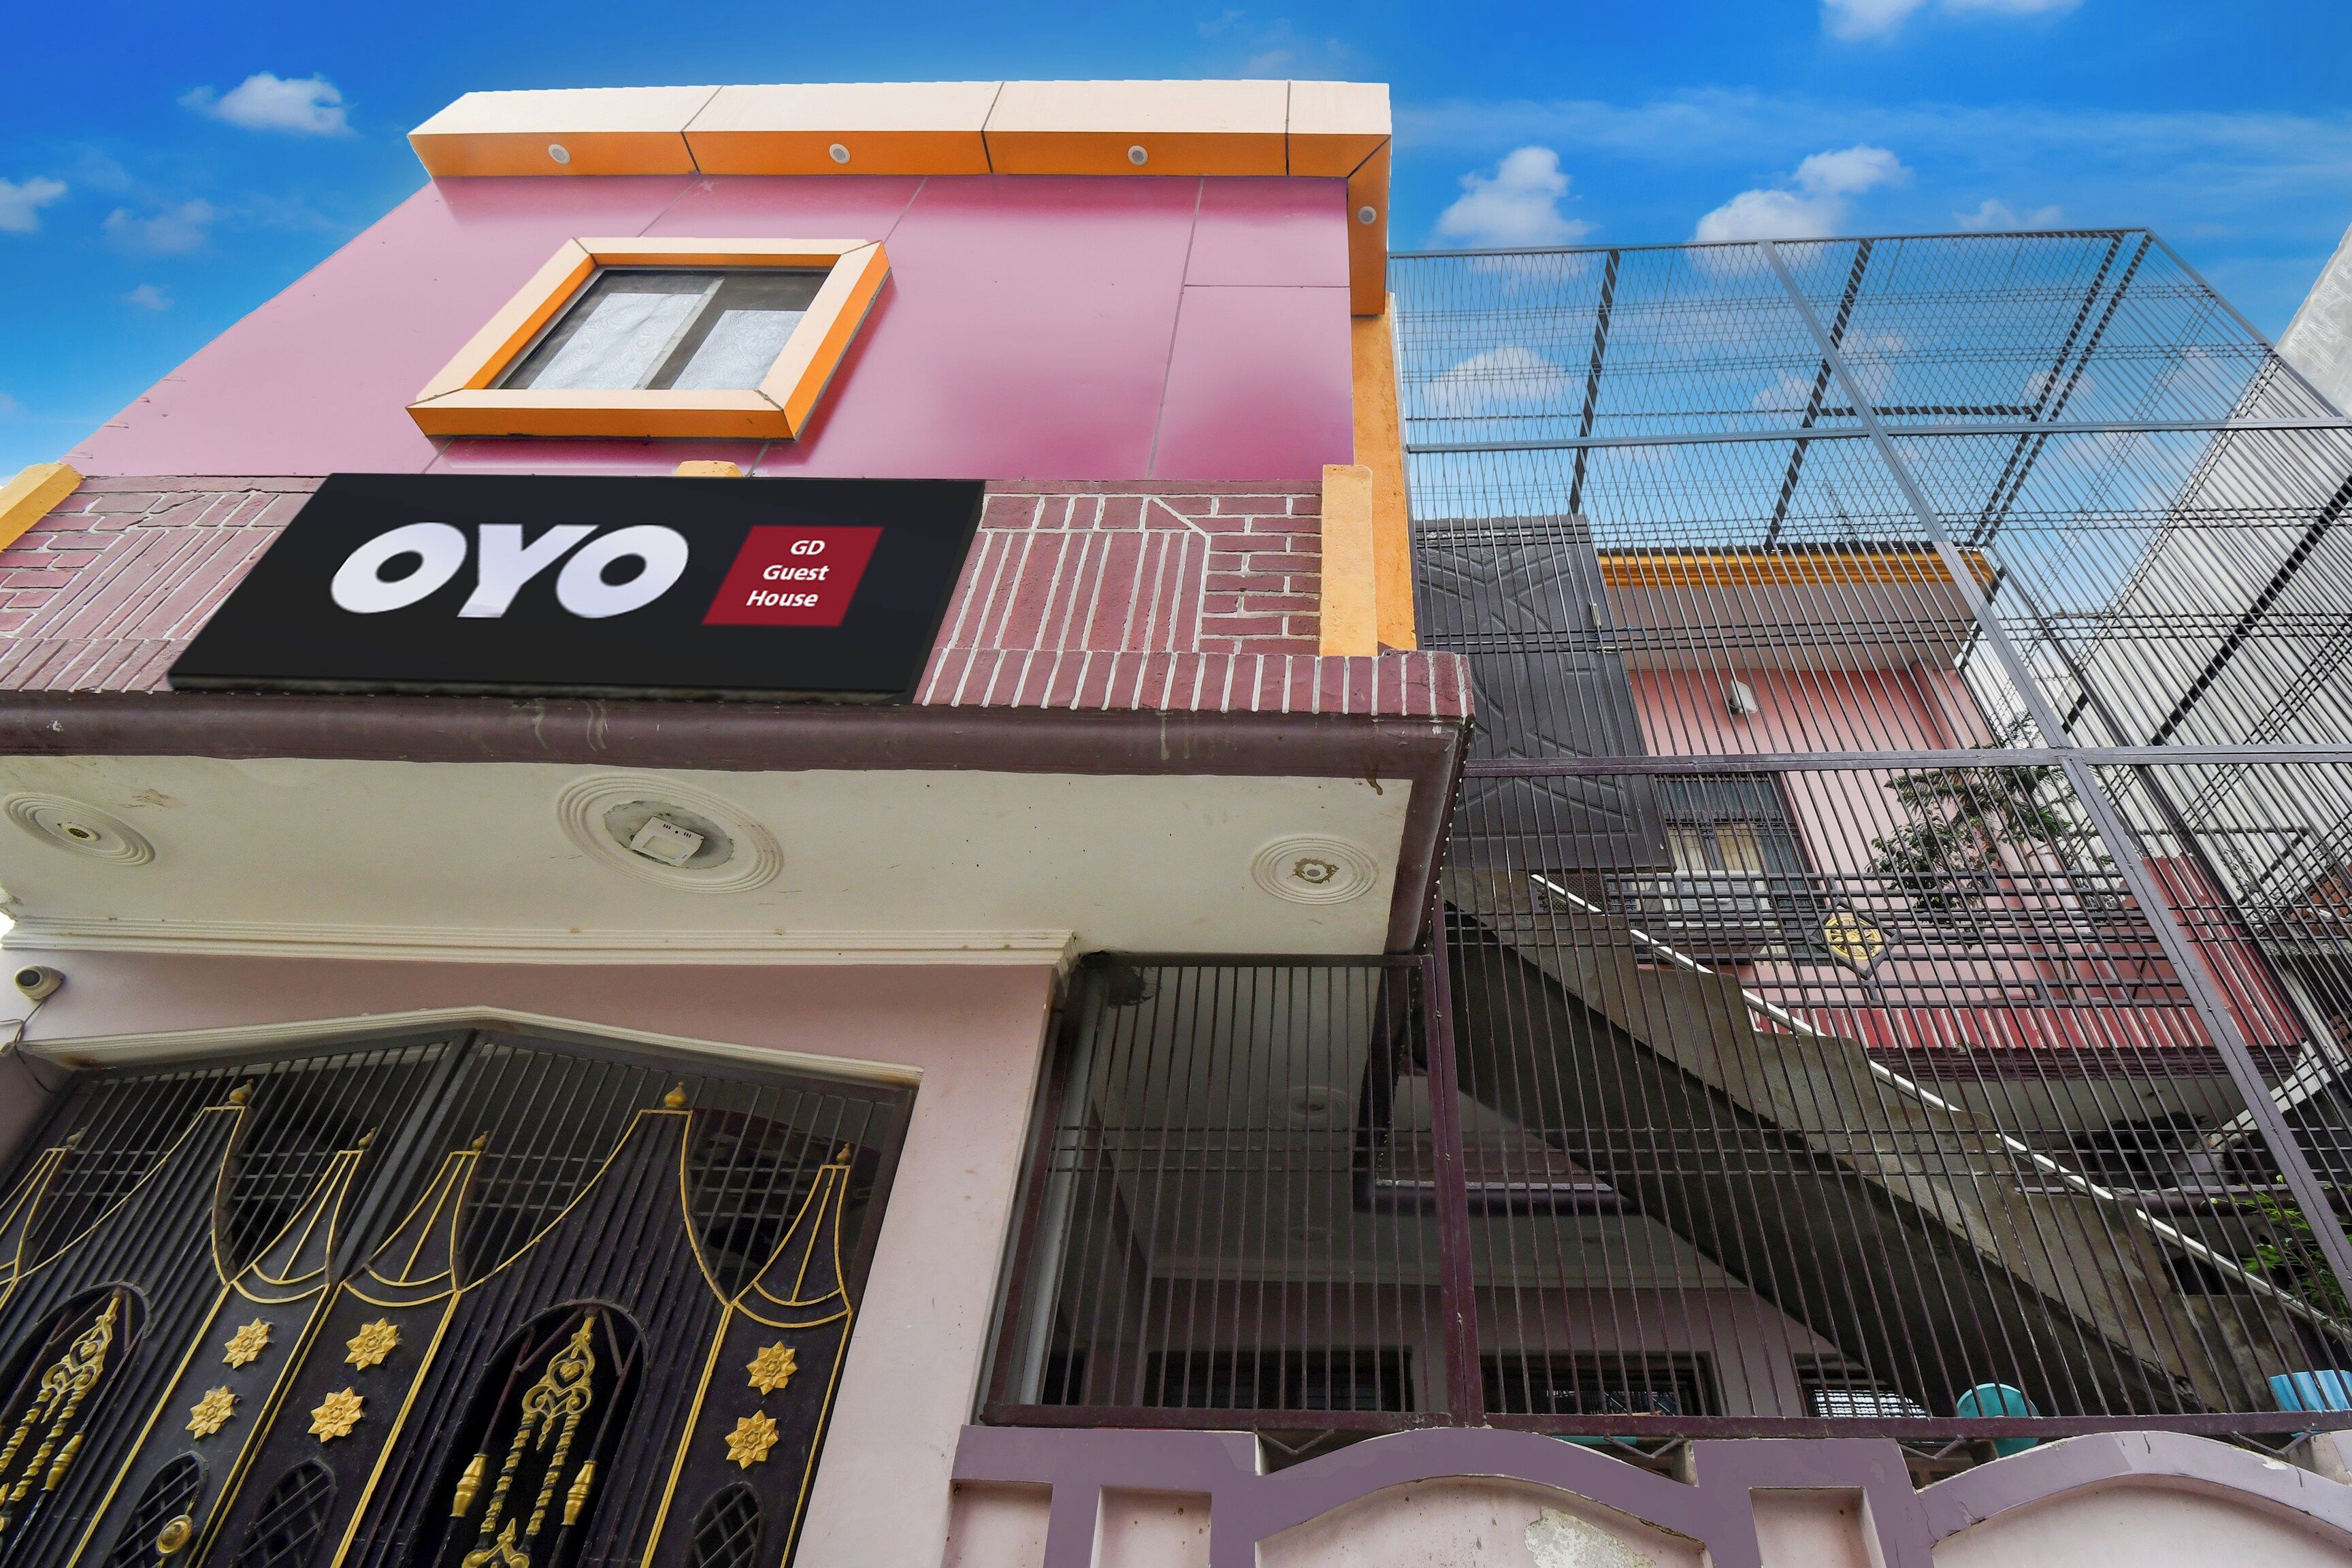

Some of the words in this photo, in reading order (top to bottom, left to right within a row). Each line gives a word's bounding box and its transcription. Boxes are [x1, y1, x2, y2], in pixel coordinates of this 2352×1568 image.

[790, 540, 826, 555] GD
[330, 522, 689, 619] OYO
[762, 564, 830, 581] Guest
[746, 590, 819, 607] House
